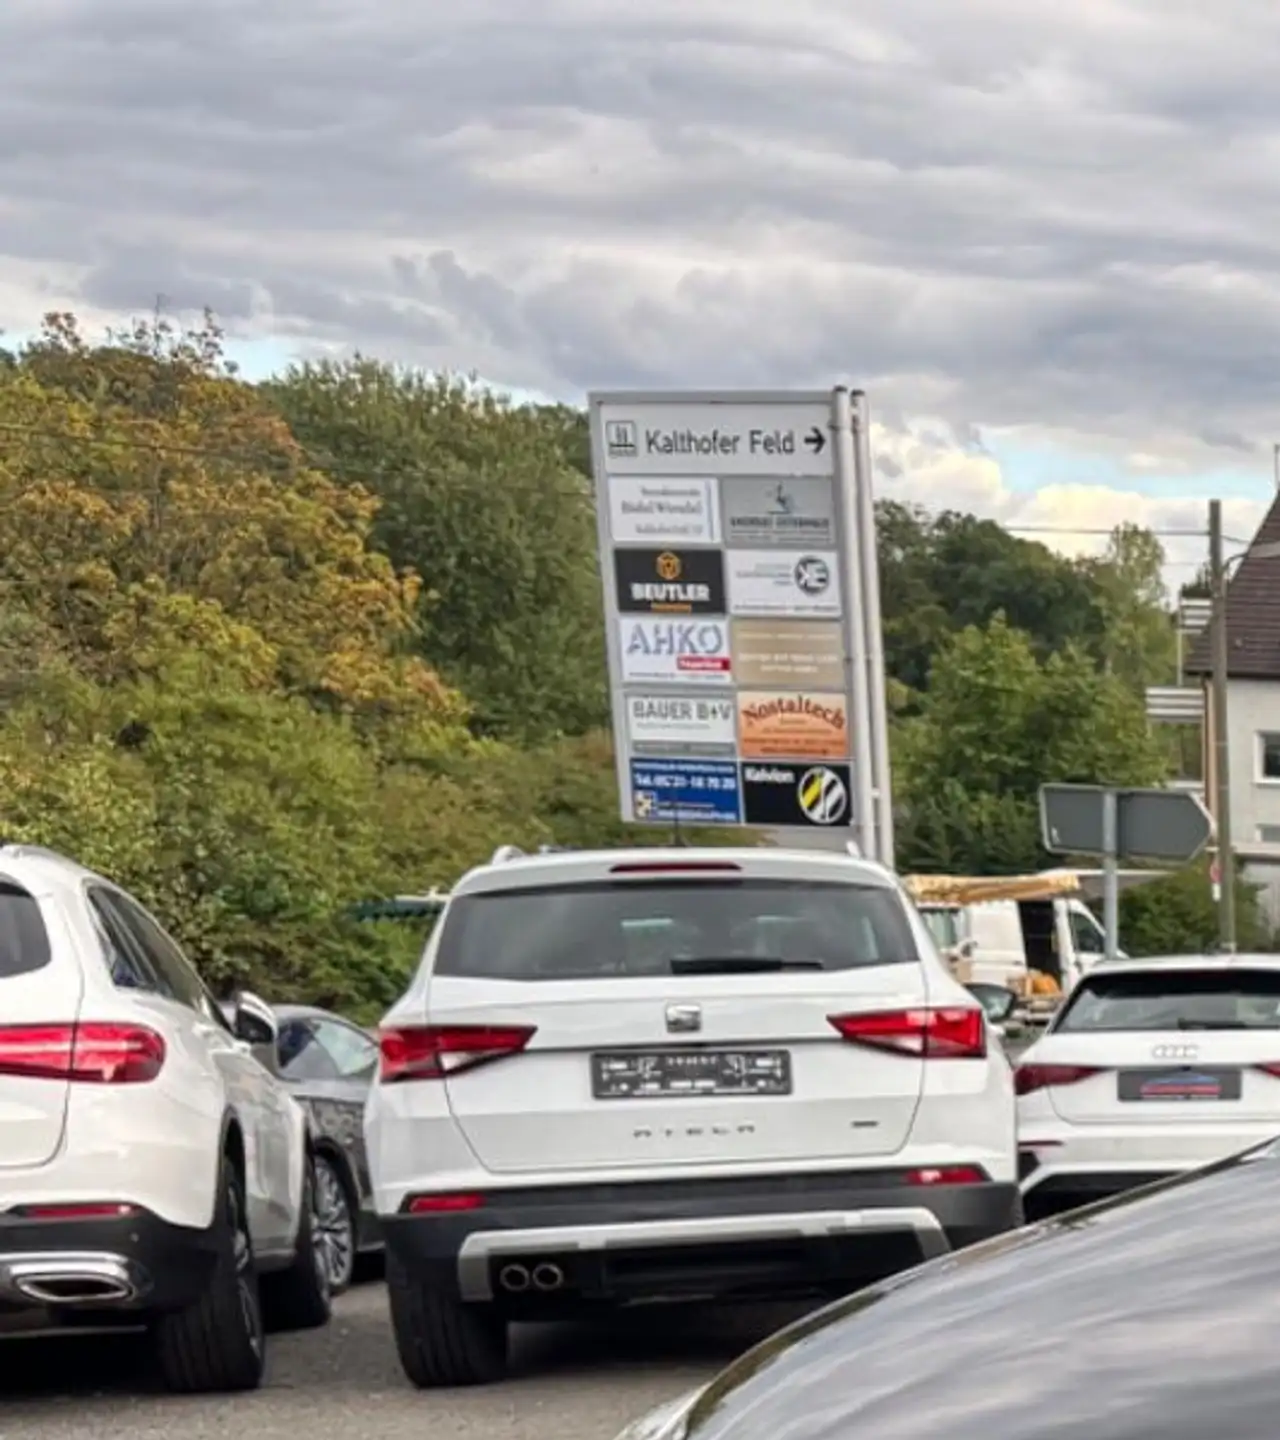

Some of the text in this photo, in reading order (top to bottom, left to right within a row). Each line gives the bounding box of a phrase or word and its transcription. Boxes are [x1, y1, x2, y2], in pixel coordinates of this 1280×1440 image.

[645, 429, 796, 454] Kalthofer Feld
[630, 582, 710, 602] BEUTLER
[626, 624, 724, 655] AHKO
[633, 700, 693, 720] BAUER
[745, 767, 796, 783] Kelvion
